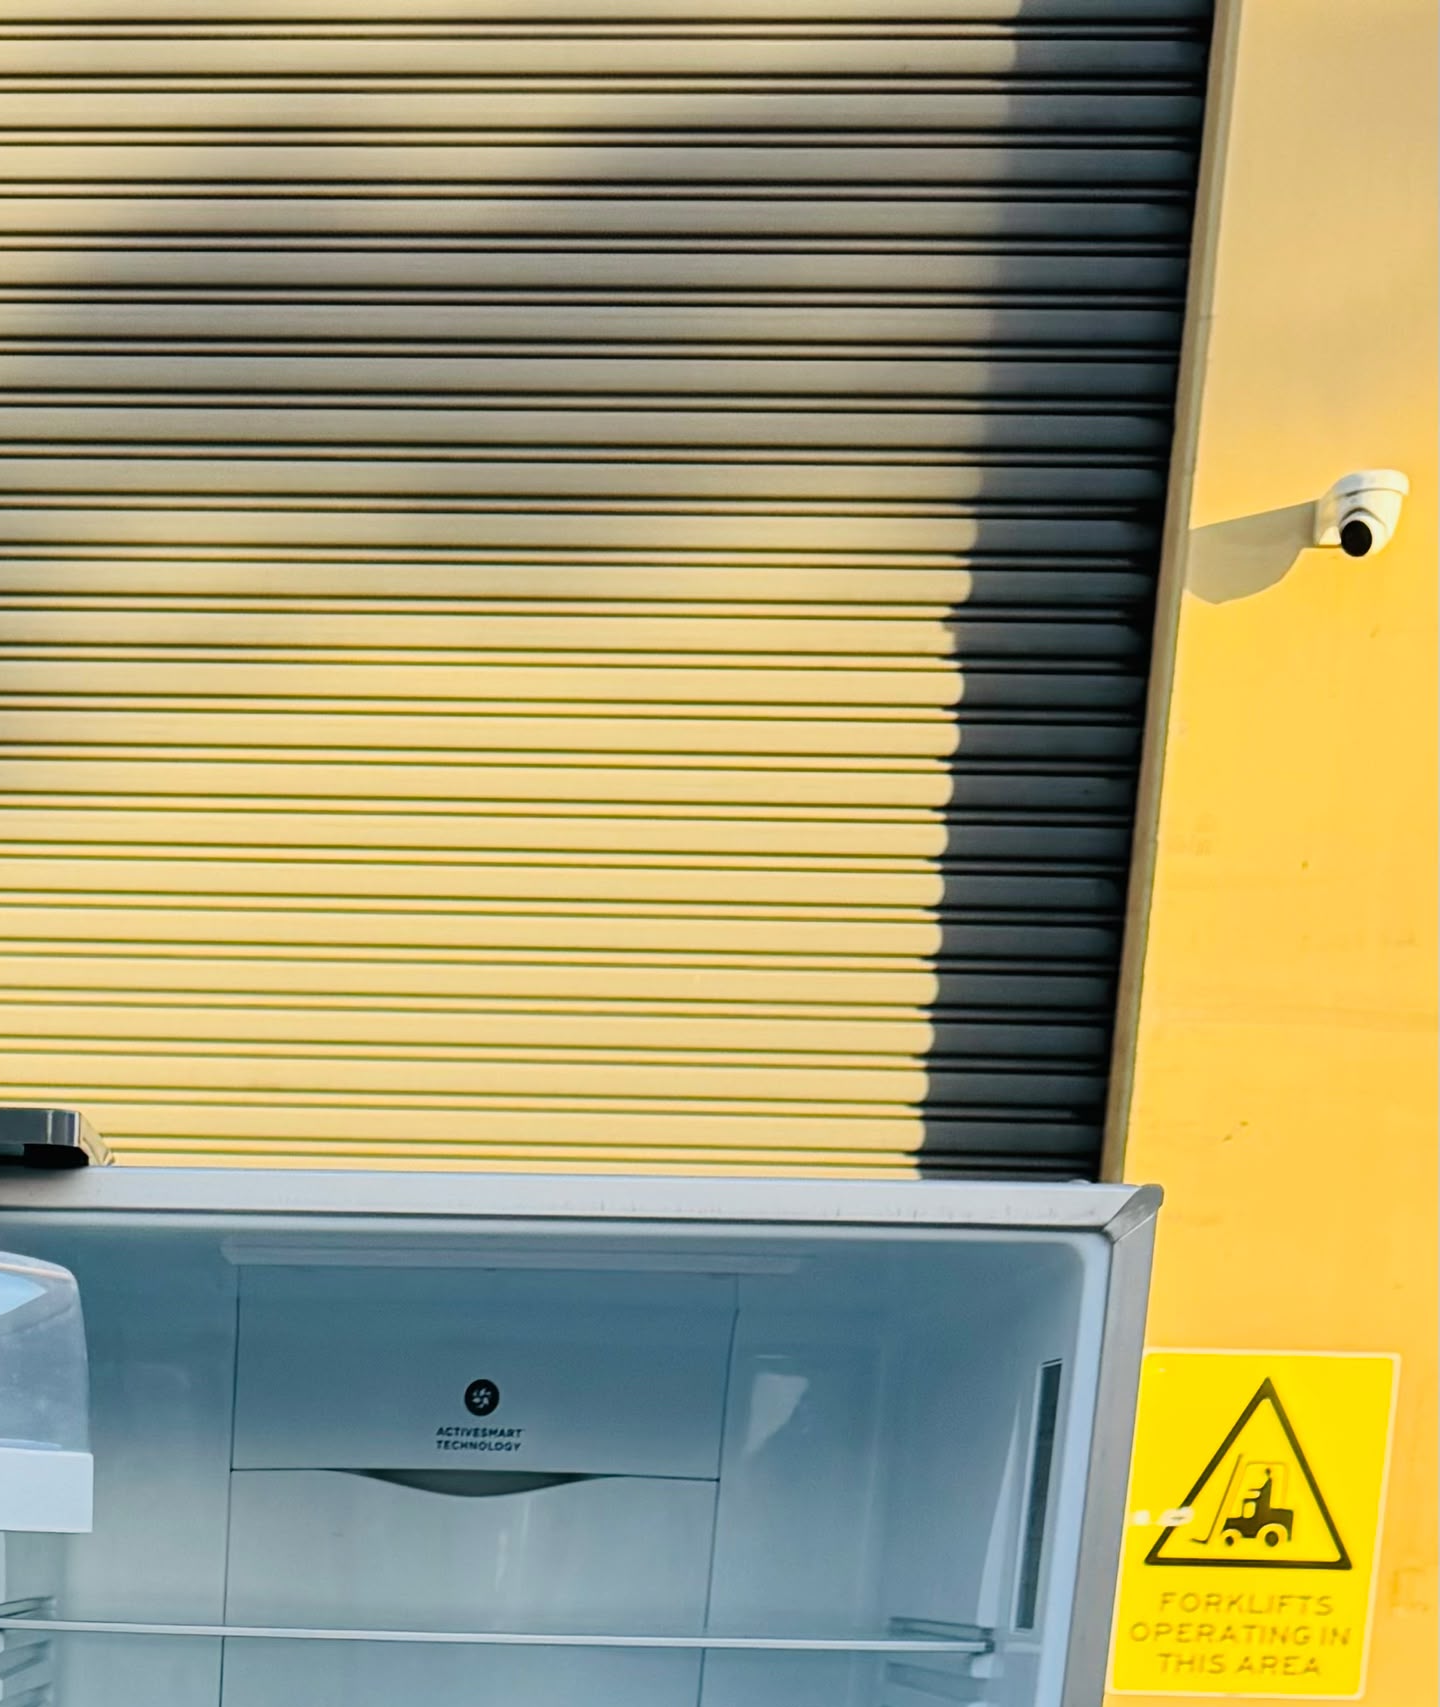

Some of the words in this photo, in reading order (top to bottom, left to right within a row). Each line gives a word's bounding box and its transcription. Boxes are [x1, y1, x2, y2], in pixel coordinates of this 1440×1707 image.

[435, 1440, 522, 1451] TECHNOLOGY
[1159, 1591, 1334, 1616] FORKLIFTS
[1129, 1621, 1311, 1646] OPERATING
[1320, 1626, 1352, 1646] IN
[1158, 1653, 1228, 1675] THIS
[1237, 1655, 1321, 1676] AREA
